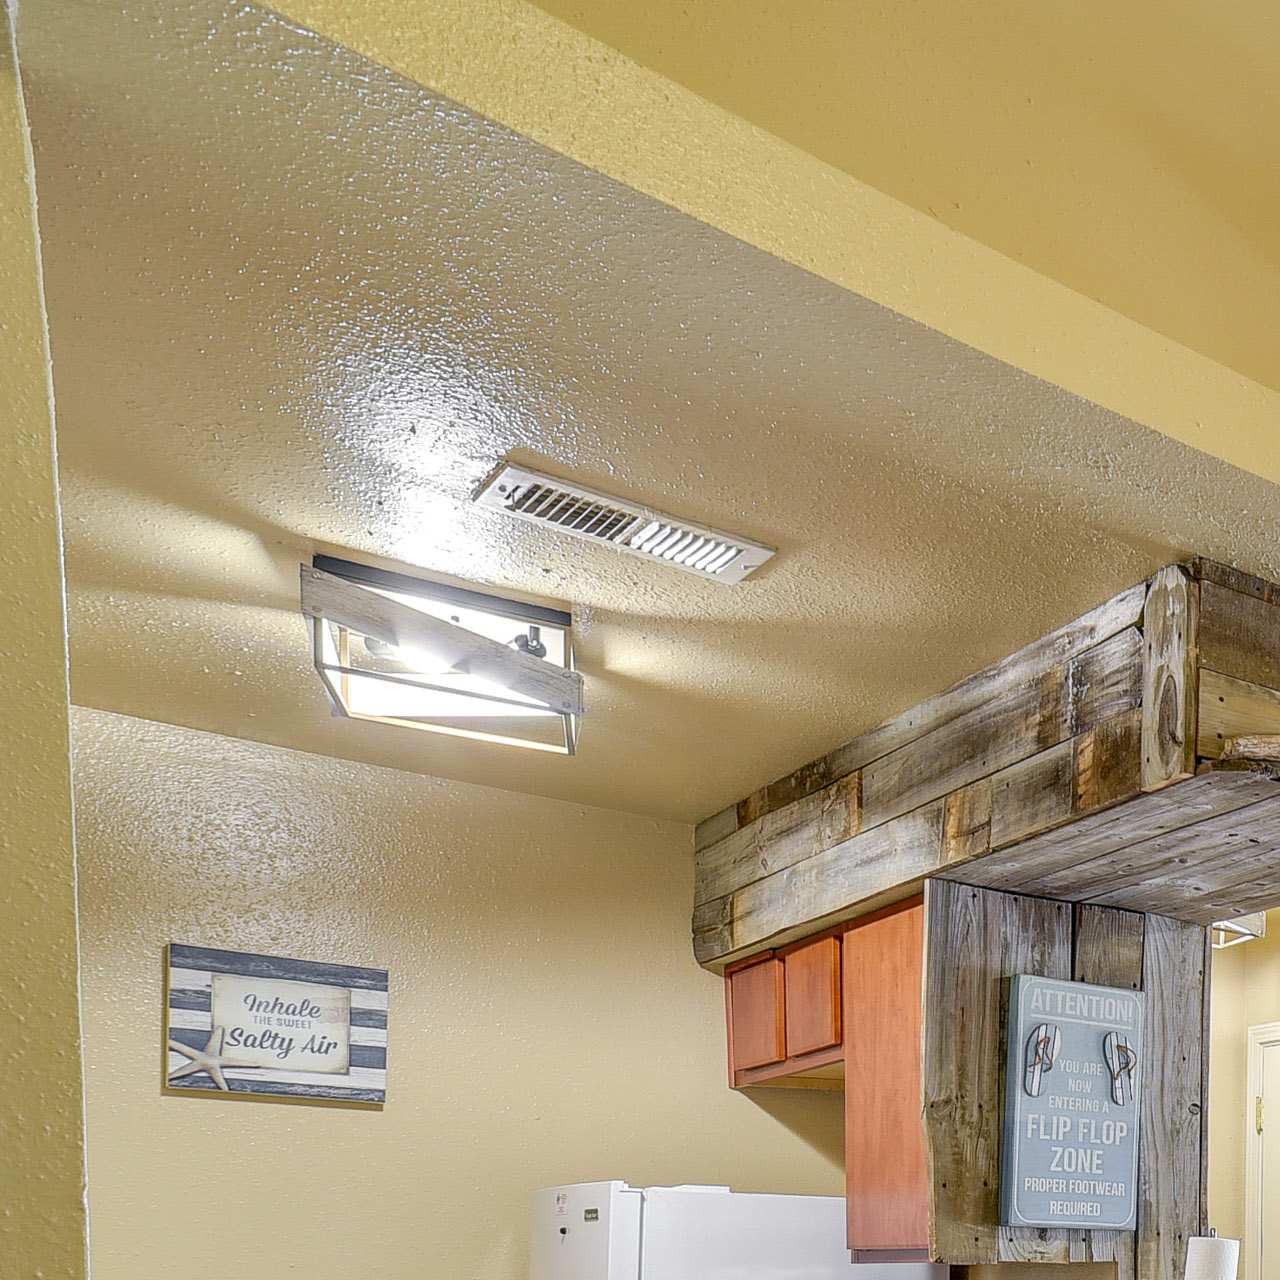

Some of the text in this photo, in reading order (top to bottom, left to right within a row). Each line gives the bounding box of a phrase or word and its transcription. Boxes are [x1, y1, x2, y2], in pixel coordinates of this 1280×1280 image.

[243, 993, 322, 1019] Inhale
[1031, 988, 1133, 1022] ATTENTION!
[253, 1015, 312, 1030] THE SWEET
[224, 1027, 338, 1059] Salty Air
[1059, 1059, 1103, 1076] YOU ARE
[1068, 1078, 1092, 1093] NOW
[1049, 1095, 1109, 1113] ENTERING A
[1026, 1114, 1128, 1145] FLIP FLOP
[1050, 1147, 1104, 1175] ZONE
[1024, 1177, 1125, 1197] PROPER FOOTWEAR
[1049, 1200, 1101, 1217] REQUIRED
